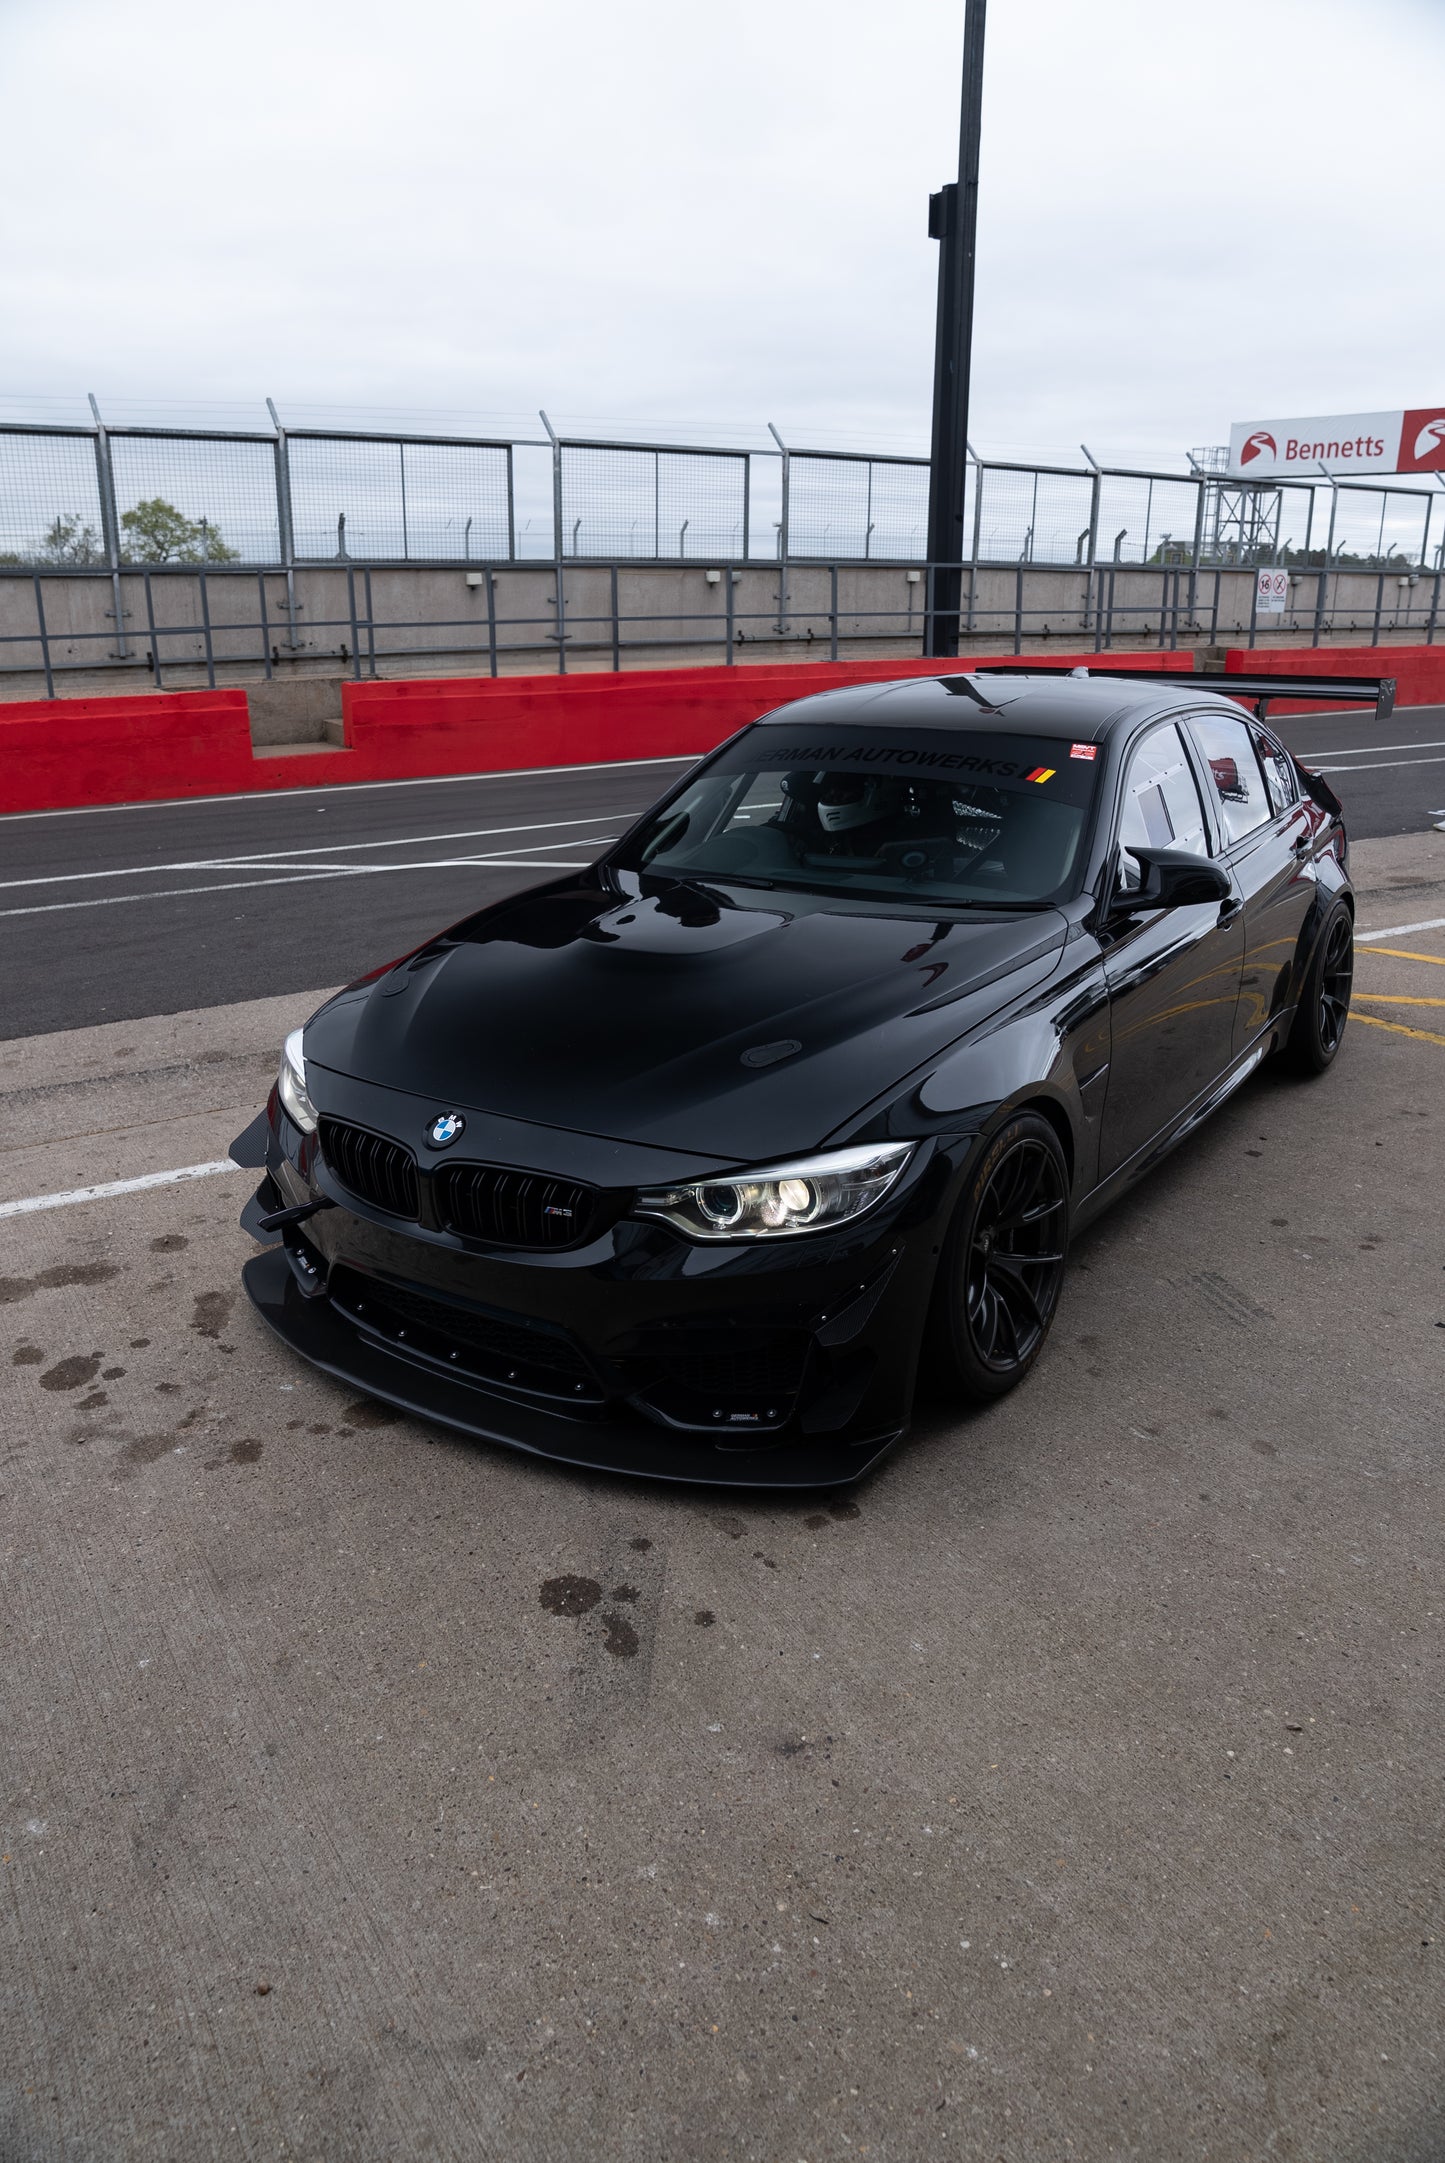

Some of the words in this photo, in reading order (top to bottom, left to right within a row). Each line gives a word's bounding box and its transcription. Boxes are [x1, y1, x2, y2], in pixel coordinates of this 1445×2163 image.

[1286, 436, 1384, 460] Bennetts
[744, 747, 845, 763] ERMAN
[843, 747, 1018, 776] AUTOWERKS
[437, 1114, 463, 1128] BMW
[974, 1124, 1019, 1202] PIRELLI
[552, 1206, 573, 1217] M3
